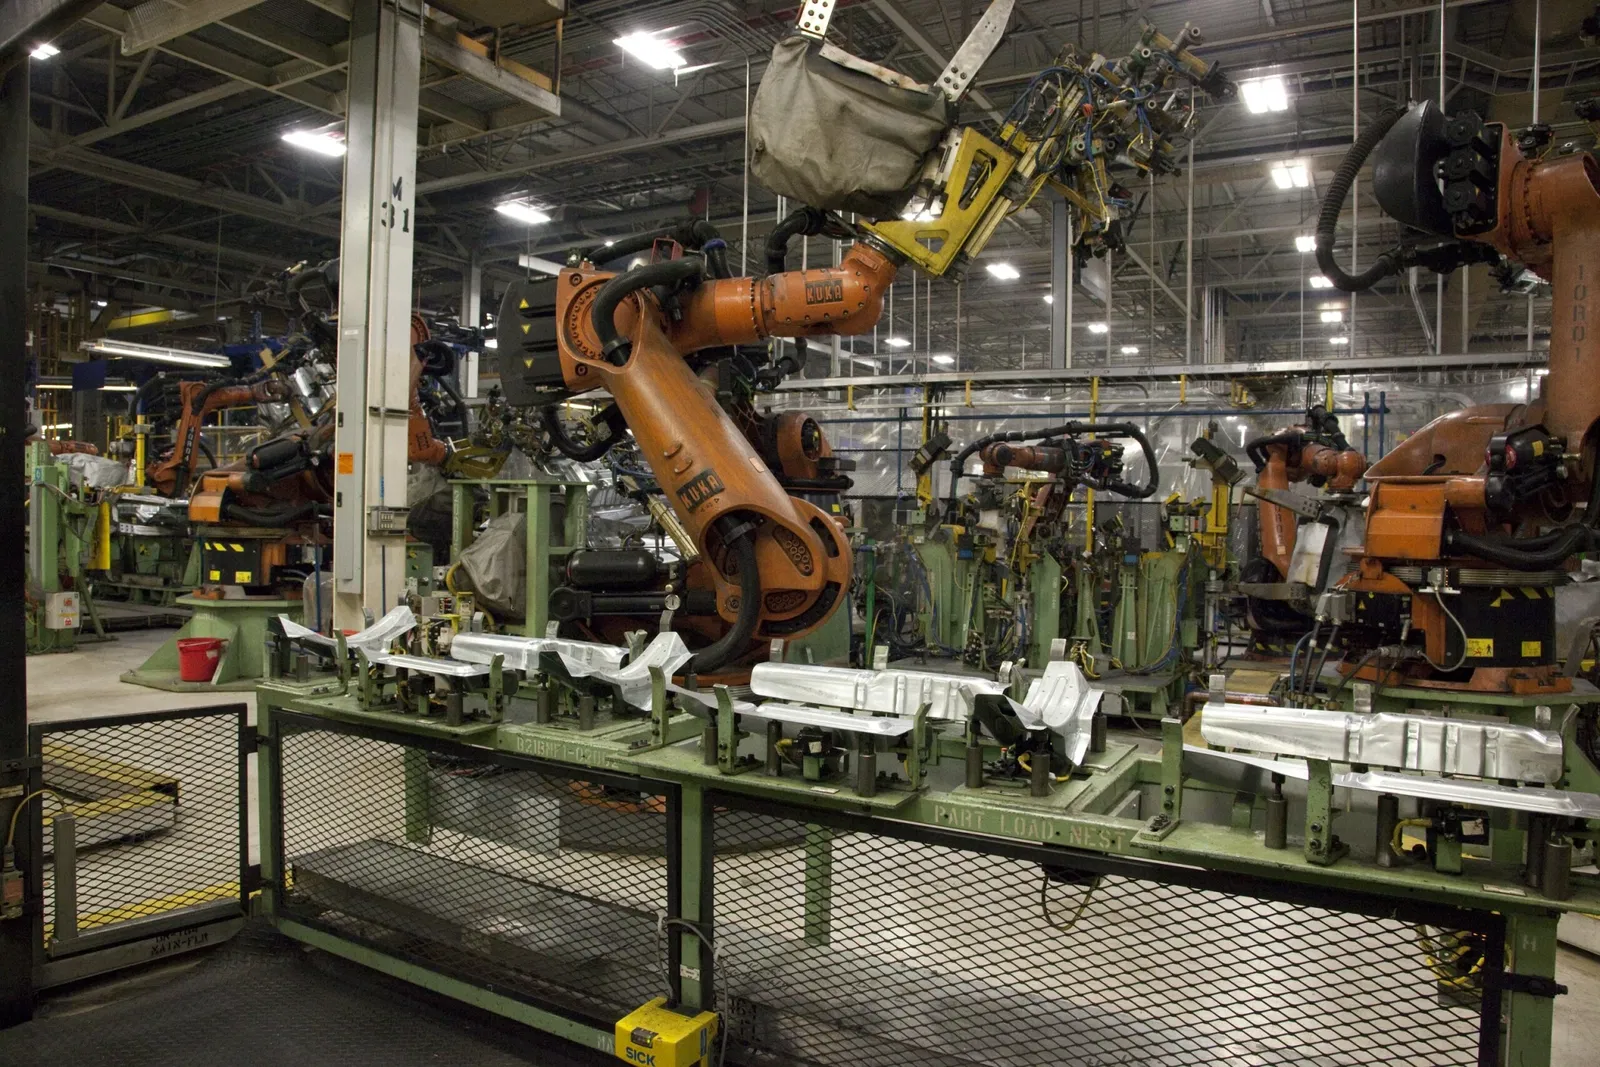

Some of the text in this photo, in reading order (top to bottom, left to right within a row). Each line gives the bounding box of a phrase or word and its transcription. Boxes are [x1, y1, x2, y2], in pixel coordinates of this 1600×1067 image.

[805, 283, 843, 303] KUKA
[680, 473, 724, 511] KUKA
[934, 804, 1127, 851] PART LOAD NEST
[625, 1045, 656, 1067] SICK
